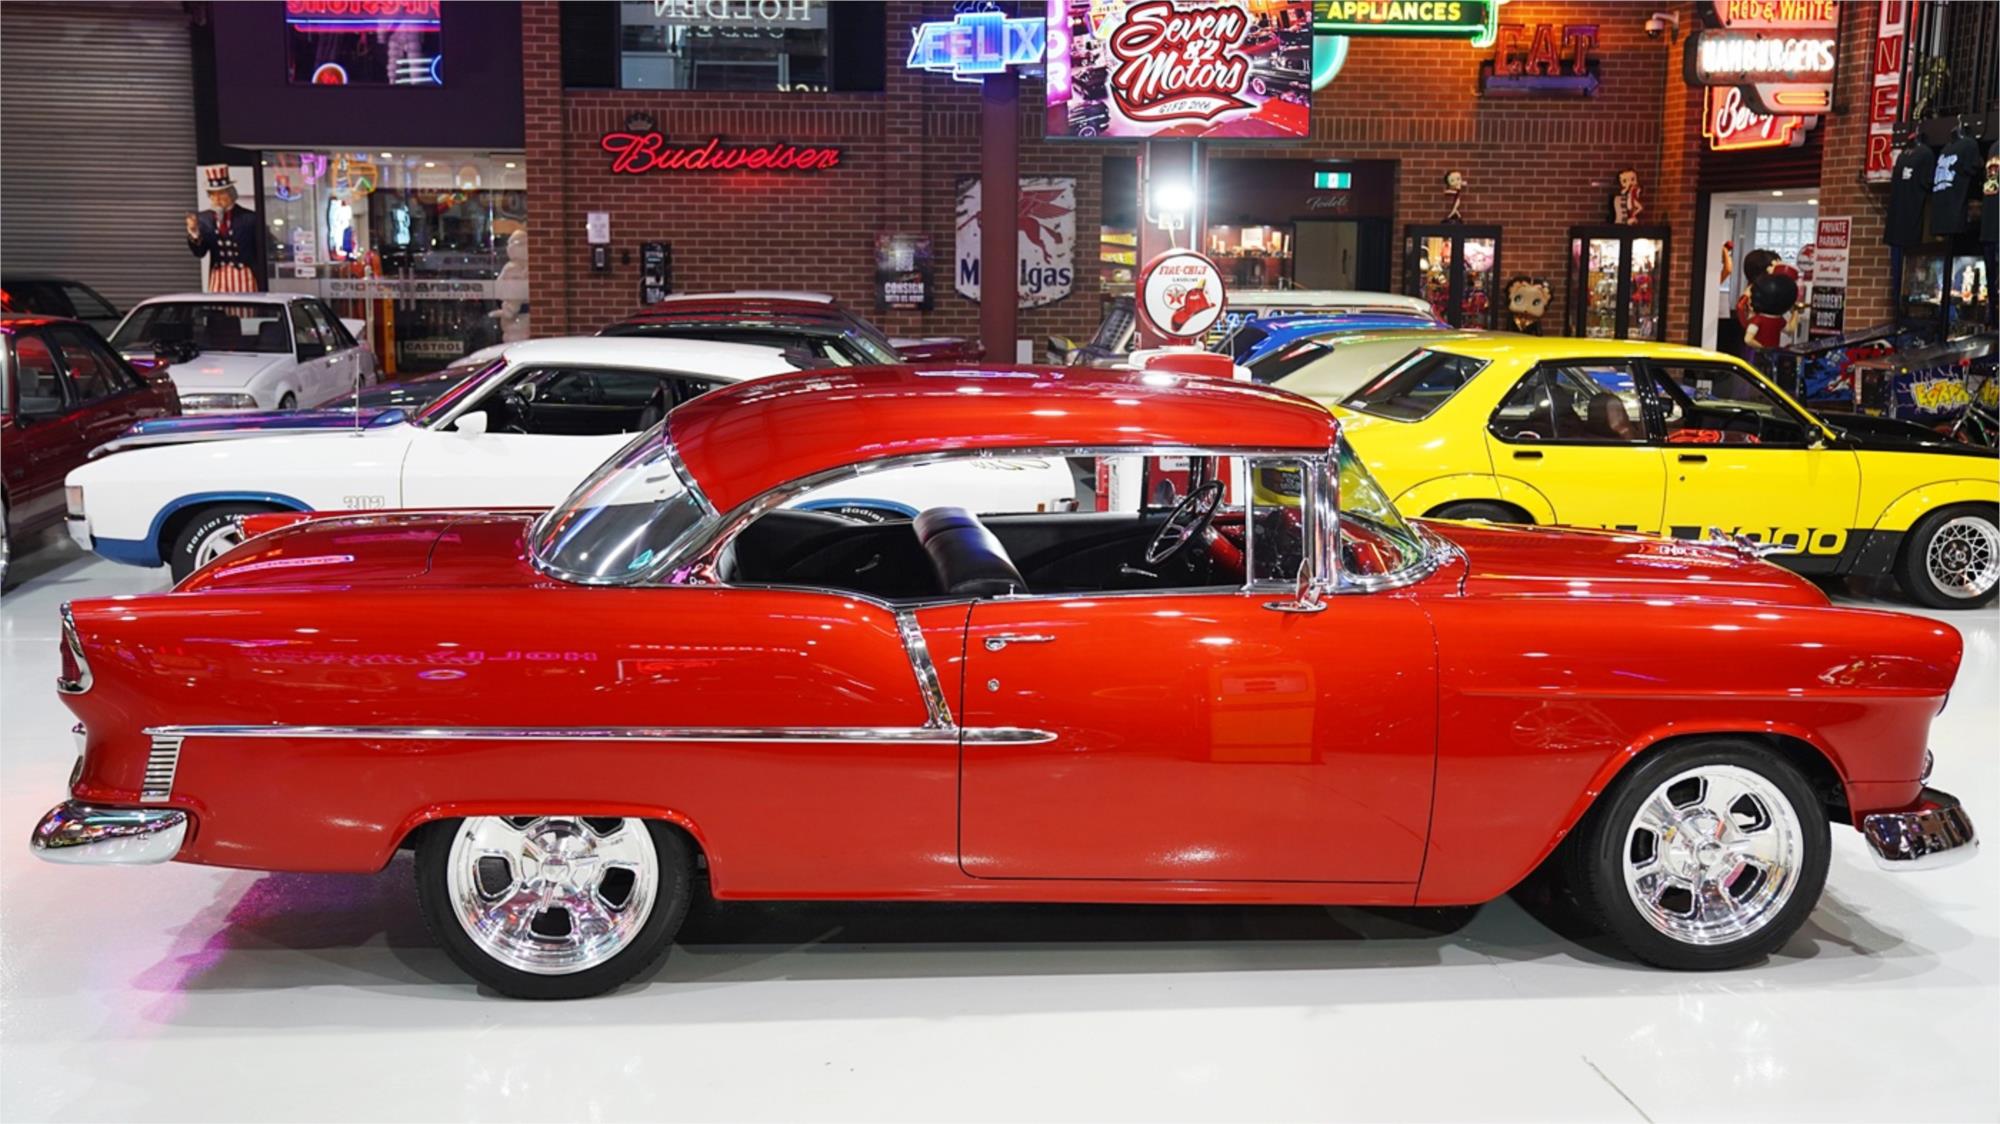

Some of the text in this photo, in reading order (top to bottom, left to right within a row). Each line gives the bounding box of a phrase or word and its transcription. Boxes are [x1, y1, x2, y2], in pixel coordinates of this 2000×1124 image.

[1326, 2, 1461, 21] APPLIANCES
[1729, 1, 1758, 20] RED
[1779, 1, 1833, 20] WHITE
[926, 23, 1039, 63] FELIX
[1116, 6, 1238, 56] Seven
[1183, 40, 1220, 60] 82
[1494, 24, 1599, 76] EAT
[1702, 38, 1835, 72] HAMBURGERS
[1118, 51, 1241, 100] Motors
[602, 132, 839, 174] Budweiser
[961, 259, 1071, 294] Mlgas
[405, 342, 463, 352] CASTROL
[841, 507, 885, 522] Radial
[186, 518, 220, 554] Radial
